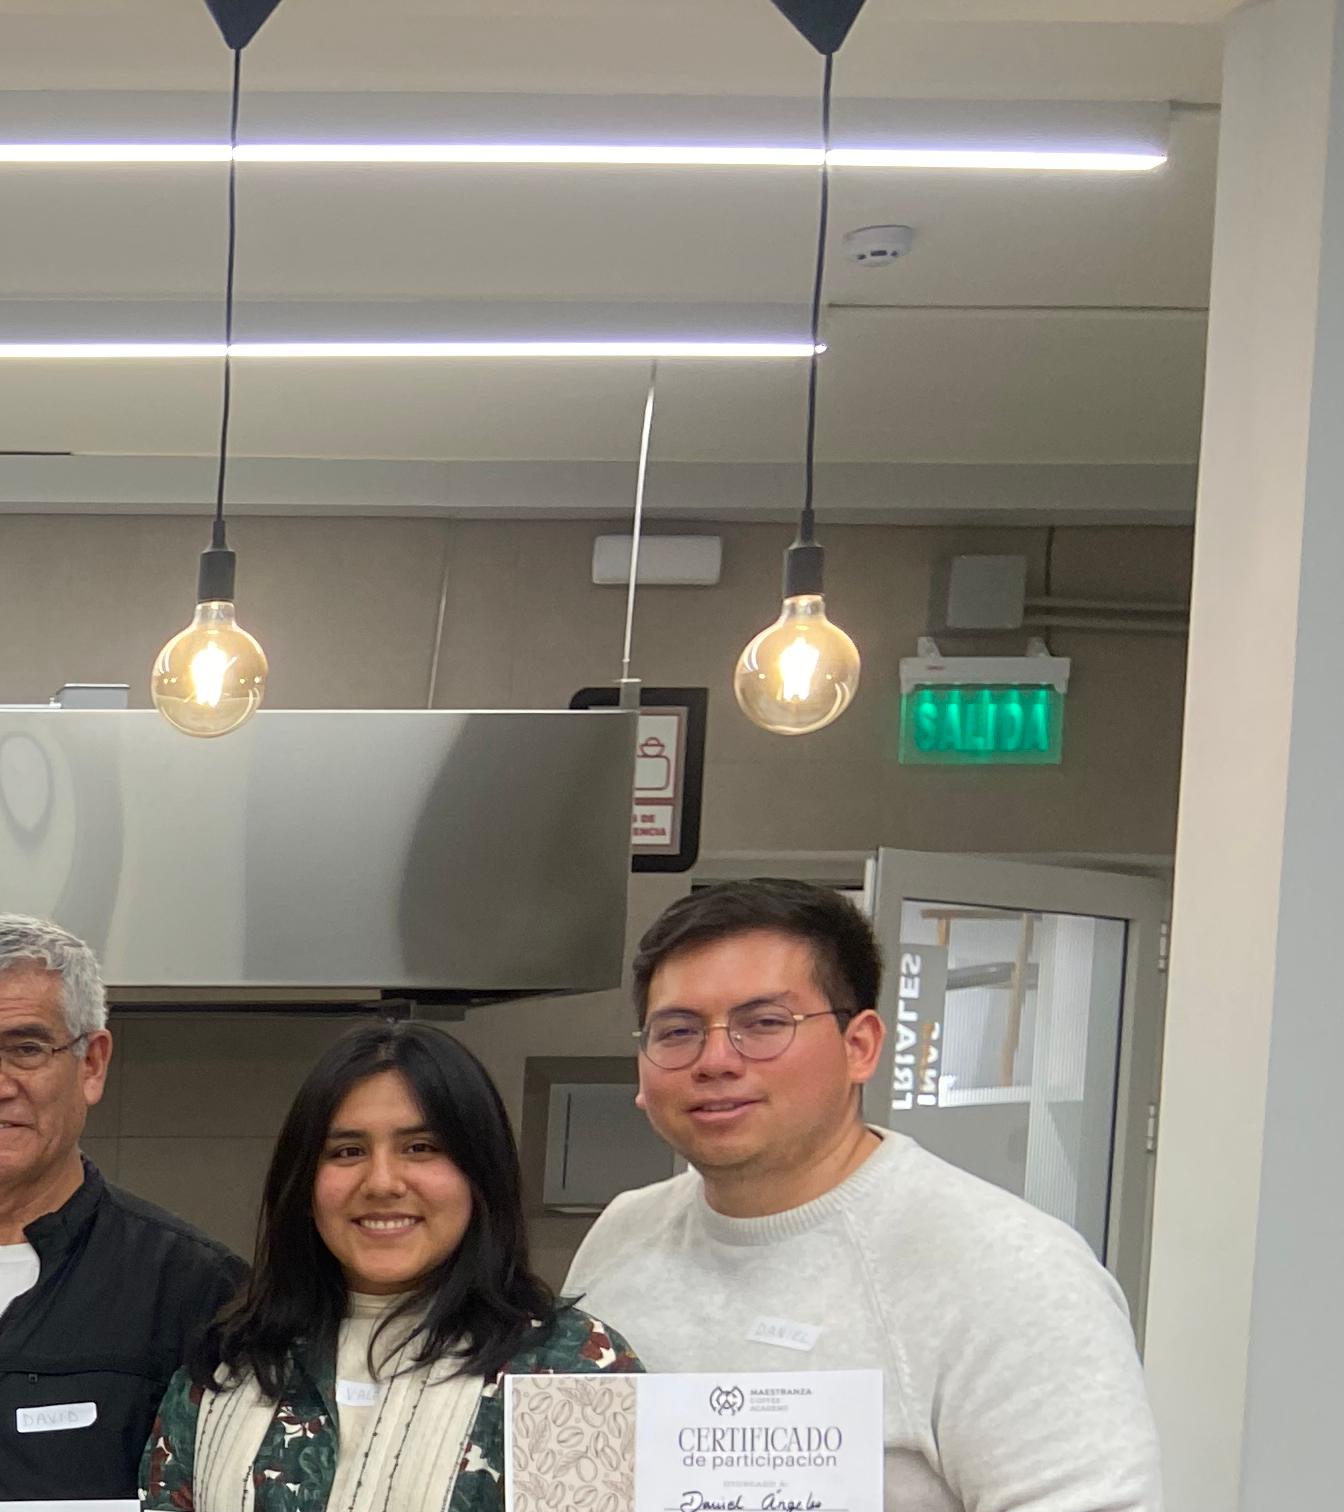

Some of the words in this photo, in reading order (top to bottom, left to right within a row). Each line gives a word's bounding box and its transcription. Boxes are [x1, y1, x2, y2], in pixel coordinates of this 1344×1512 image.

[918, 703, 1049, 752] SALIDA
[750, 1388, 812, 1396] MAESTRANZA
[22, 1410, 79, 1427] DAVID
[678, 1426, 842, 1452] CERTIFICADO
[682, 1453, 706, 1467] de
[712, 1453, 837, 1470] participación
